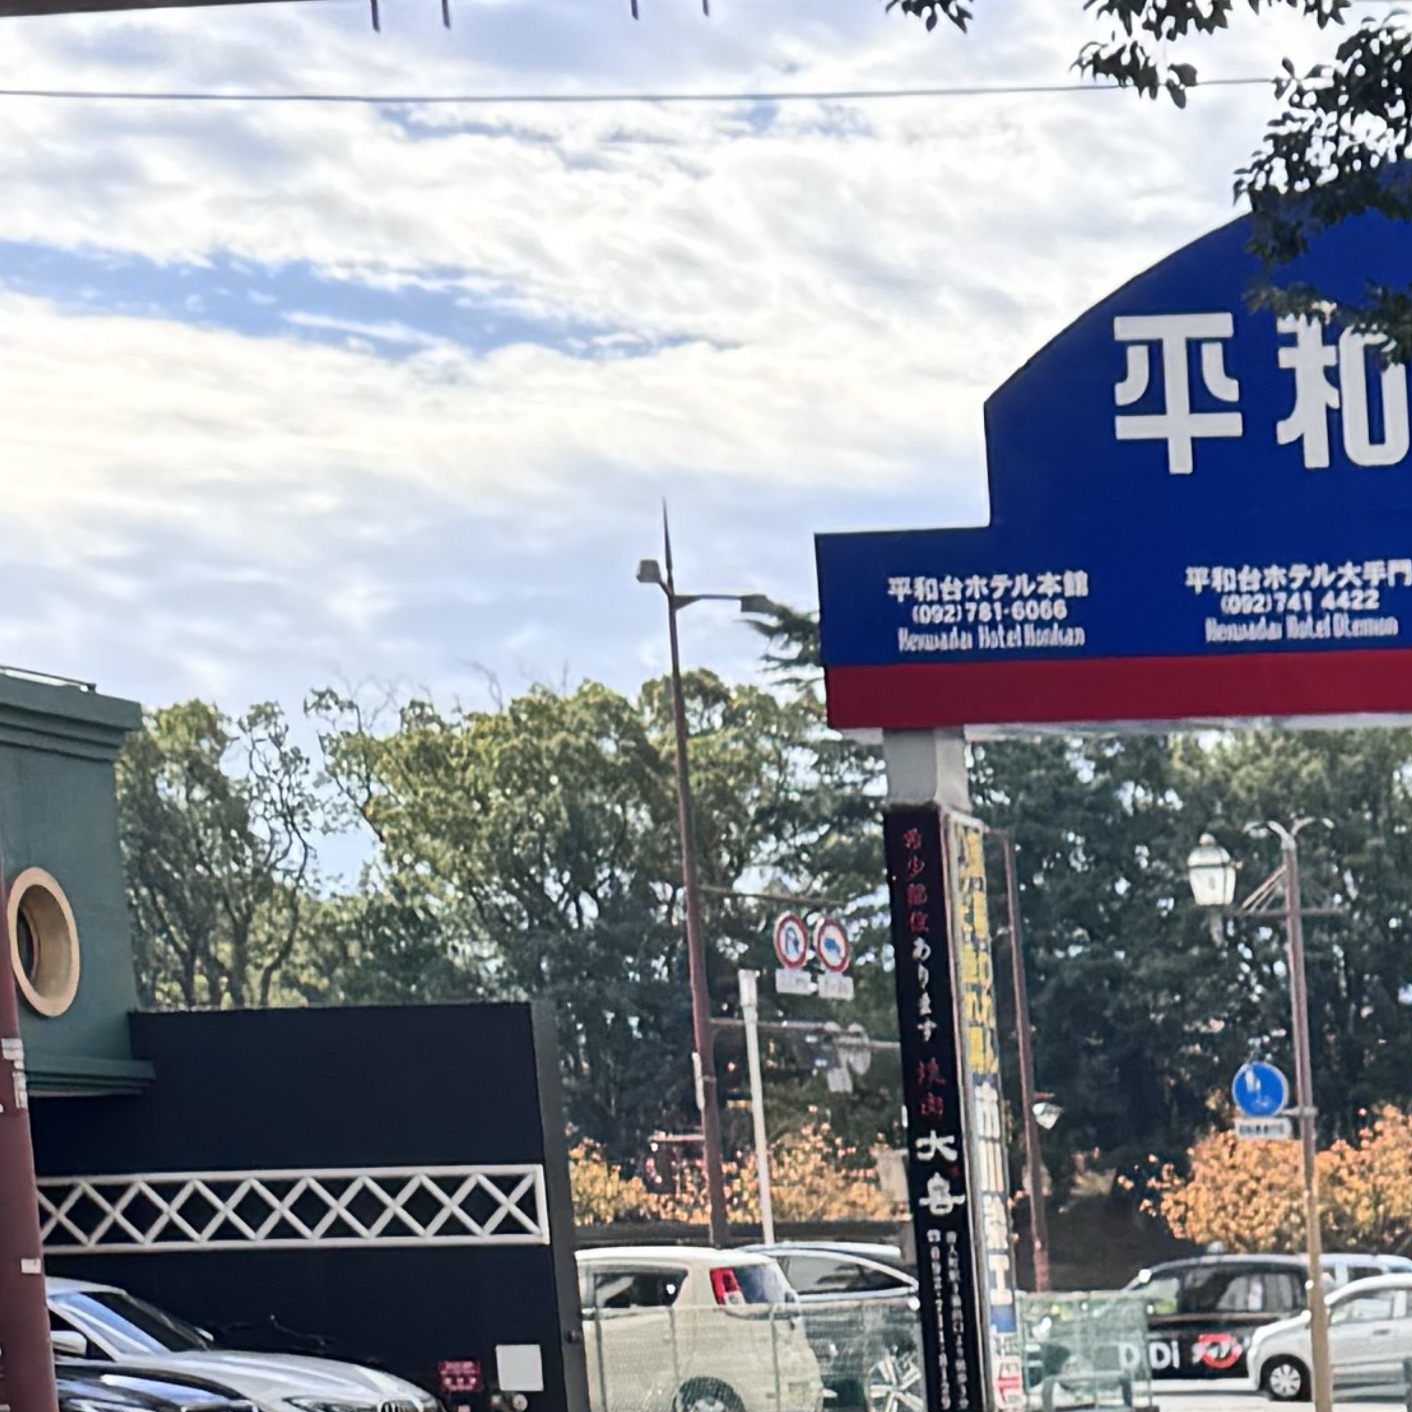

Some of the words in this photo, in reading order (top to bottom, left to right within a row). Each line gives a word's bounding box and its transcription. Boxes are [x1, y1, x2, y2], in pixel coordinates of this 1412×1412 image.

[887, 569, 1089, 603] 平和台ホテル本館
